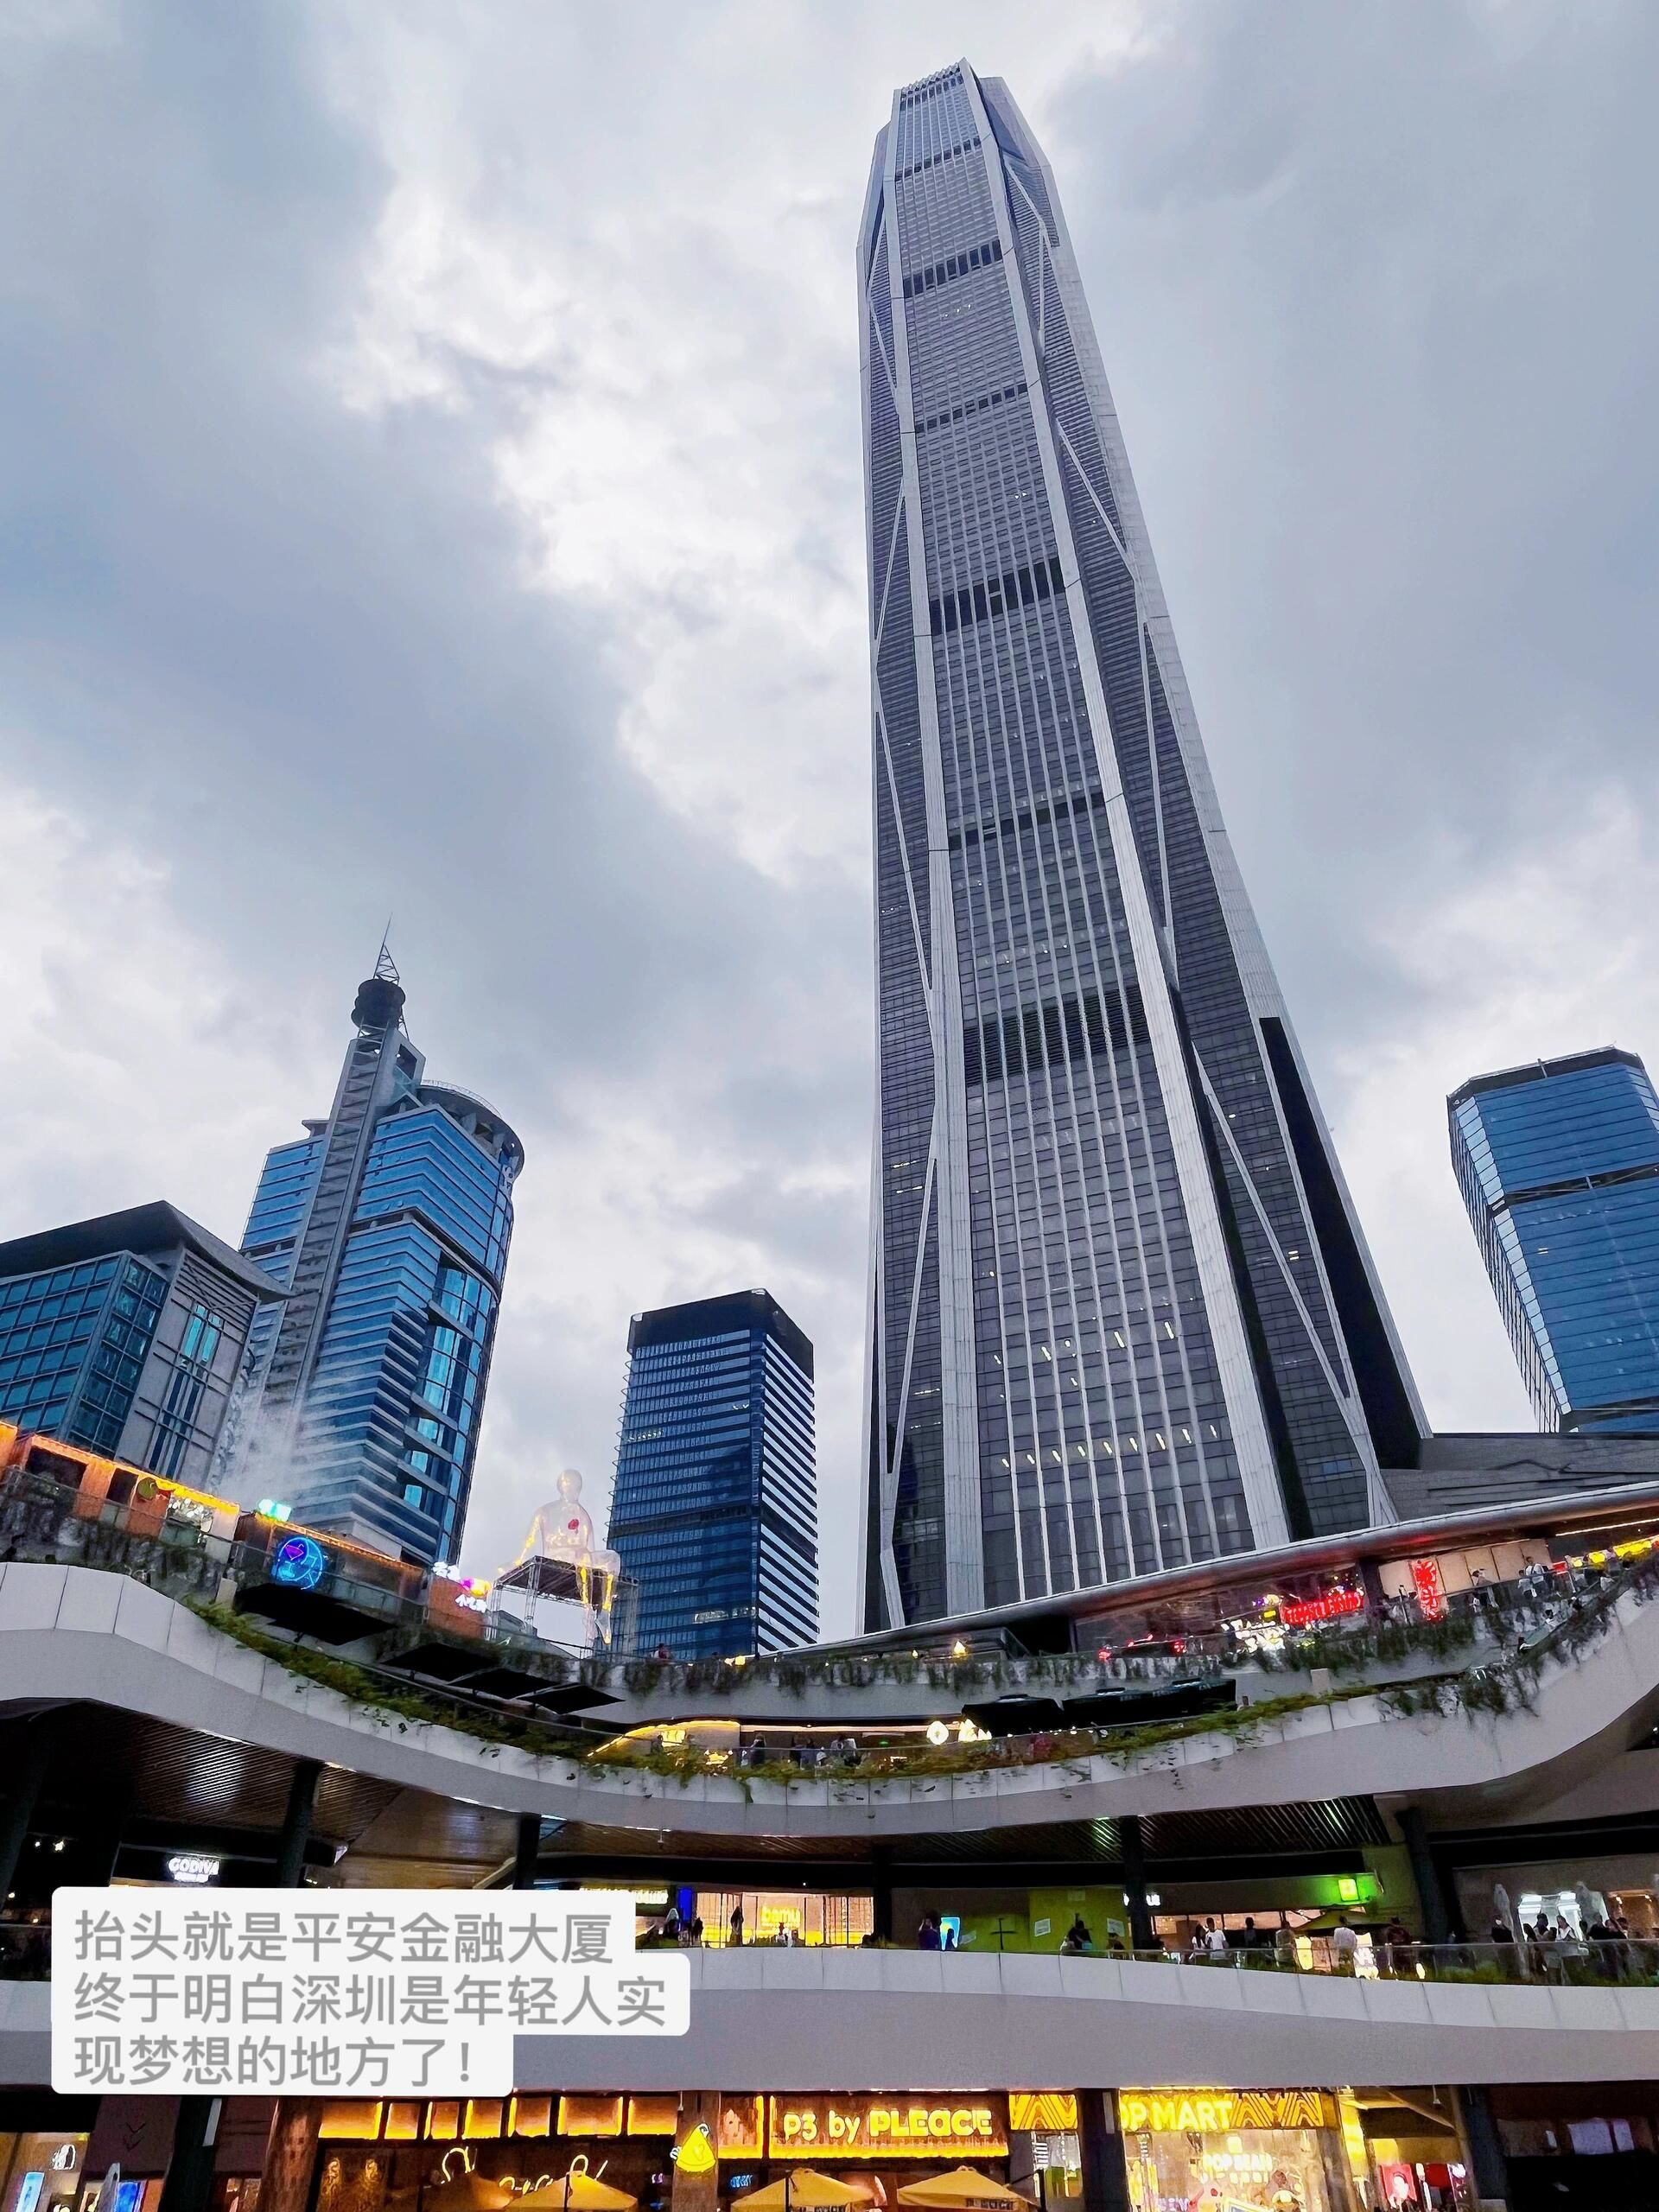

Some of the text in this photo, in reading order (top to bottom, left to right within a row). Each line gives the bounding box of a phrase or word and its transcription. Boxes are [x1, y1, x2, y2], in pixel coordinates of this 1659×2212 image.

[168, 1857, 220, 1876] GODIVA
[829, 2109, 861, 2145] by
[1154, 2101, 1232, 2131] MART
